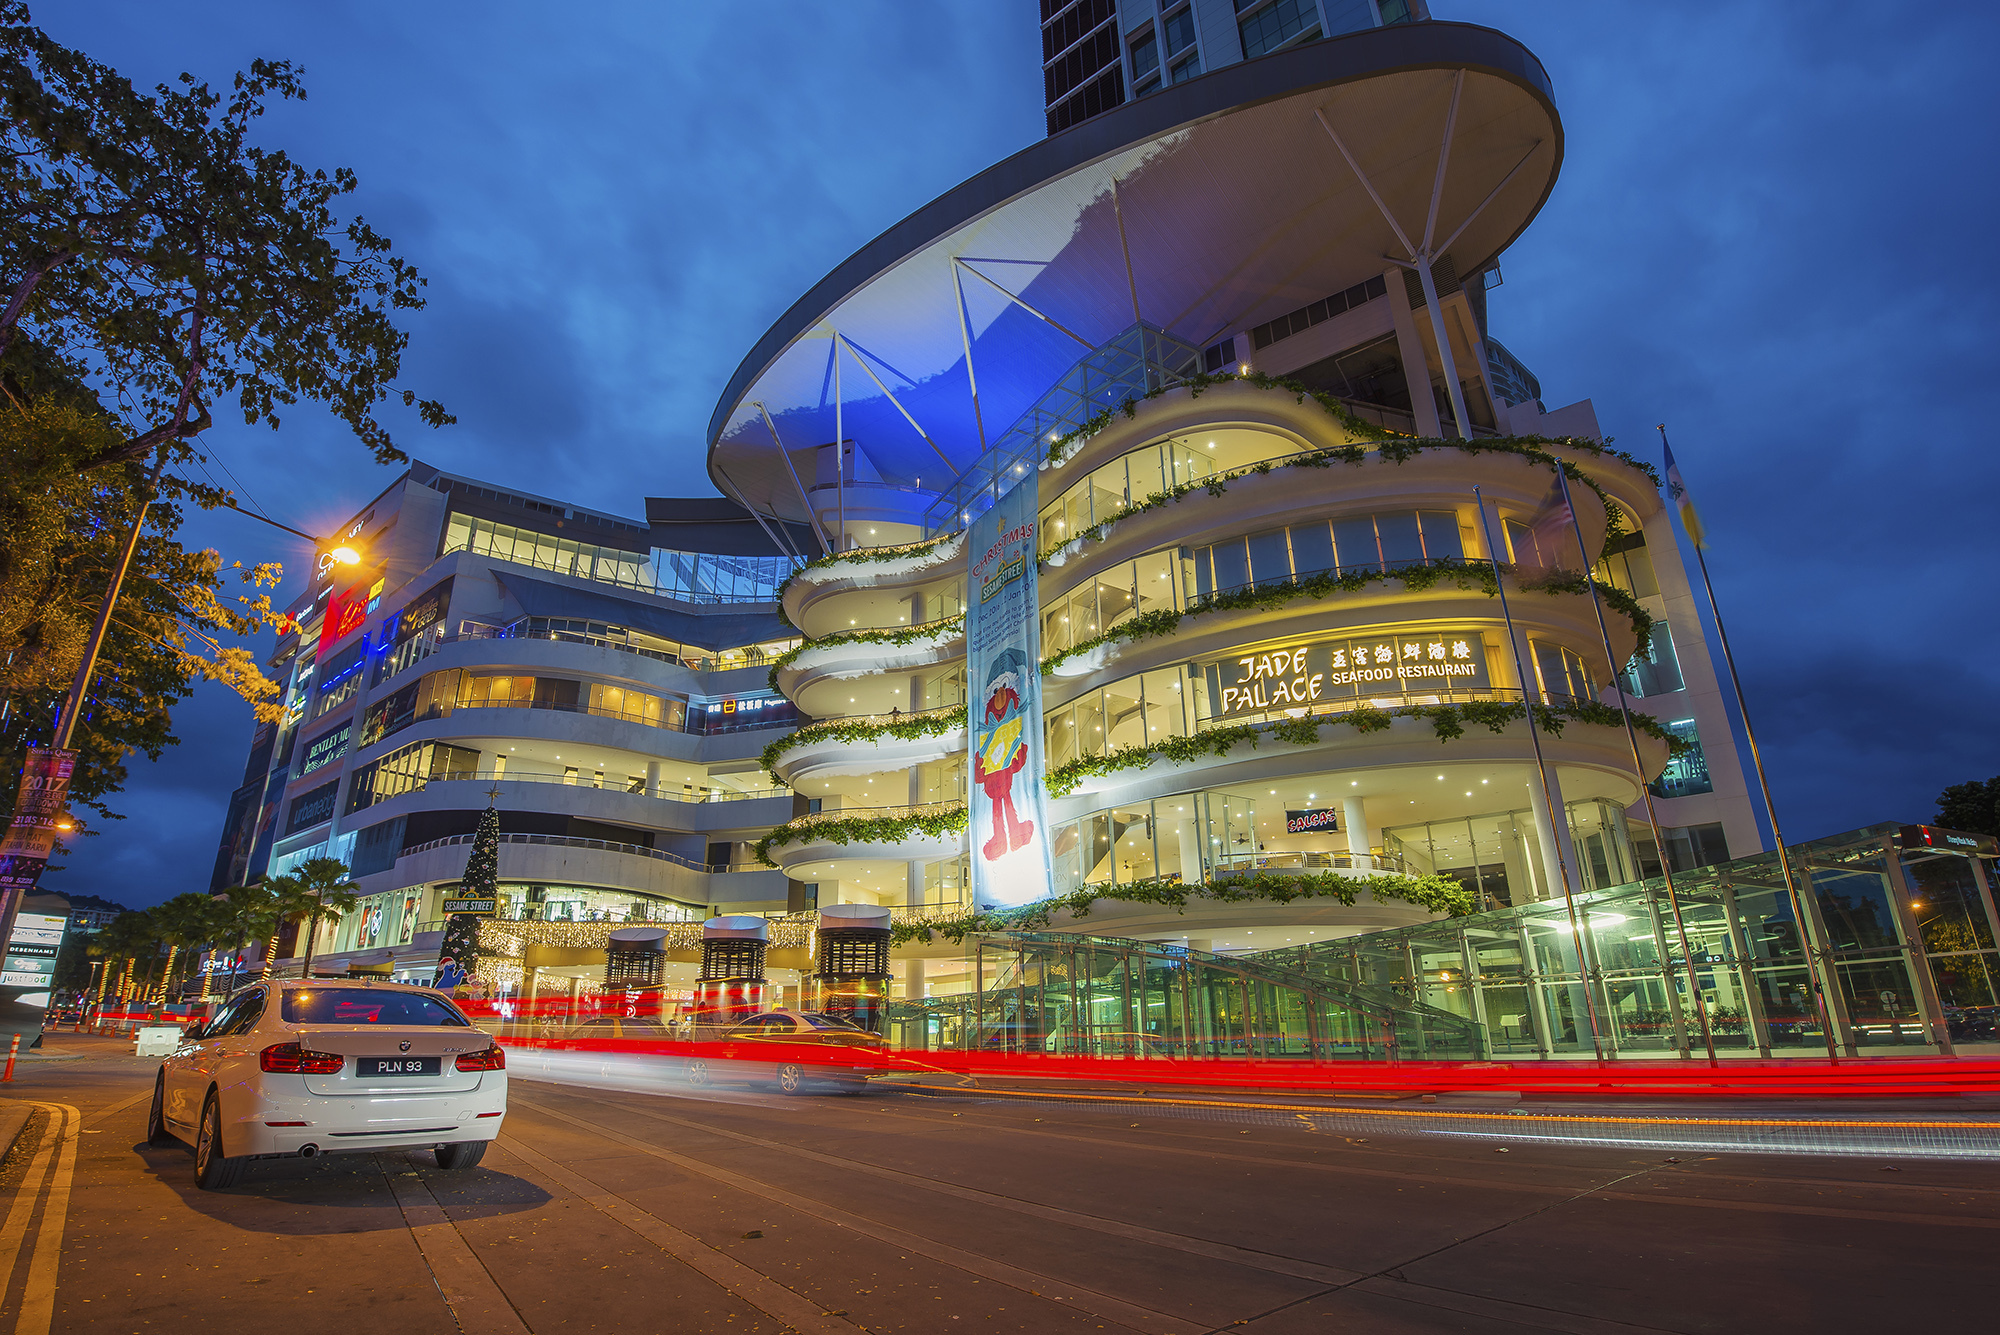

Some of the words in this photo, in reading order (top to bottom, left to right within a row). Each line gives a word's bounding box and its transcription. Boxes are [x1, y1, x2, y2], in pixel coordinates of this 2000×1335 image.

[972, 522, 1034, 578] CHRISTMAS
[1008, 590, 1022, 601] Jan
[1236, 647, 1308, 683] JADE
[1332, 667, 1393, 685] SEAFOOD
[1397, 663, 1476, 679] RESTAURANT
[1222, 673, 1323, 713] PALACE
[309, 732, 340, 759] BENTLEY
[54, 749, 75, 759] Quay
[22, 775, 69, 792] 2017
[14, 815, 24, 824] 31
[40, 816, 54, 827] '16
[1287, 809, 1336, 832] SALSAS
[25, 842, 47, 852] BARU
[444, 901, 469, 911] SESAME
[470, 901, 494, 911] STREET
[9, 946, 54, 955] DEBENHAMS
[377, 1061, 402, 1073] PLN
[406, 1060, 423, 1072] 93
